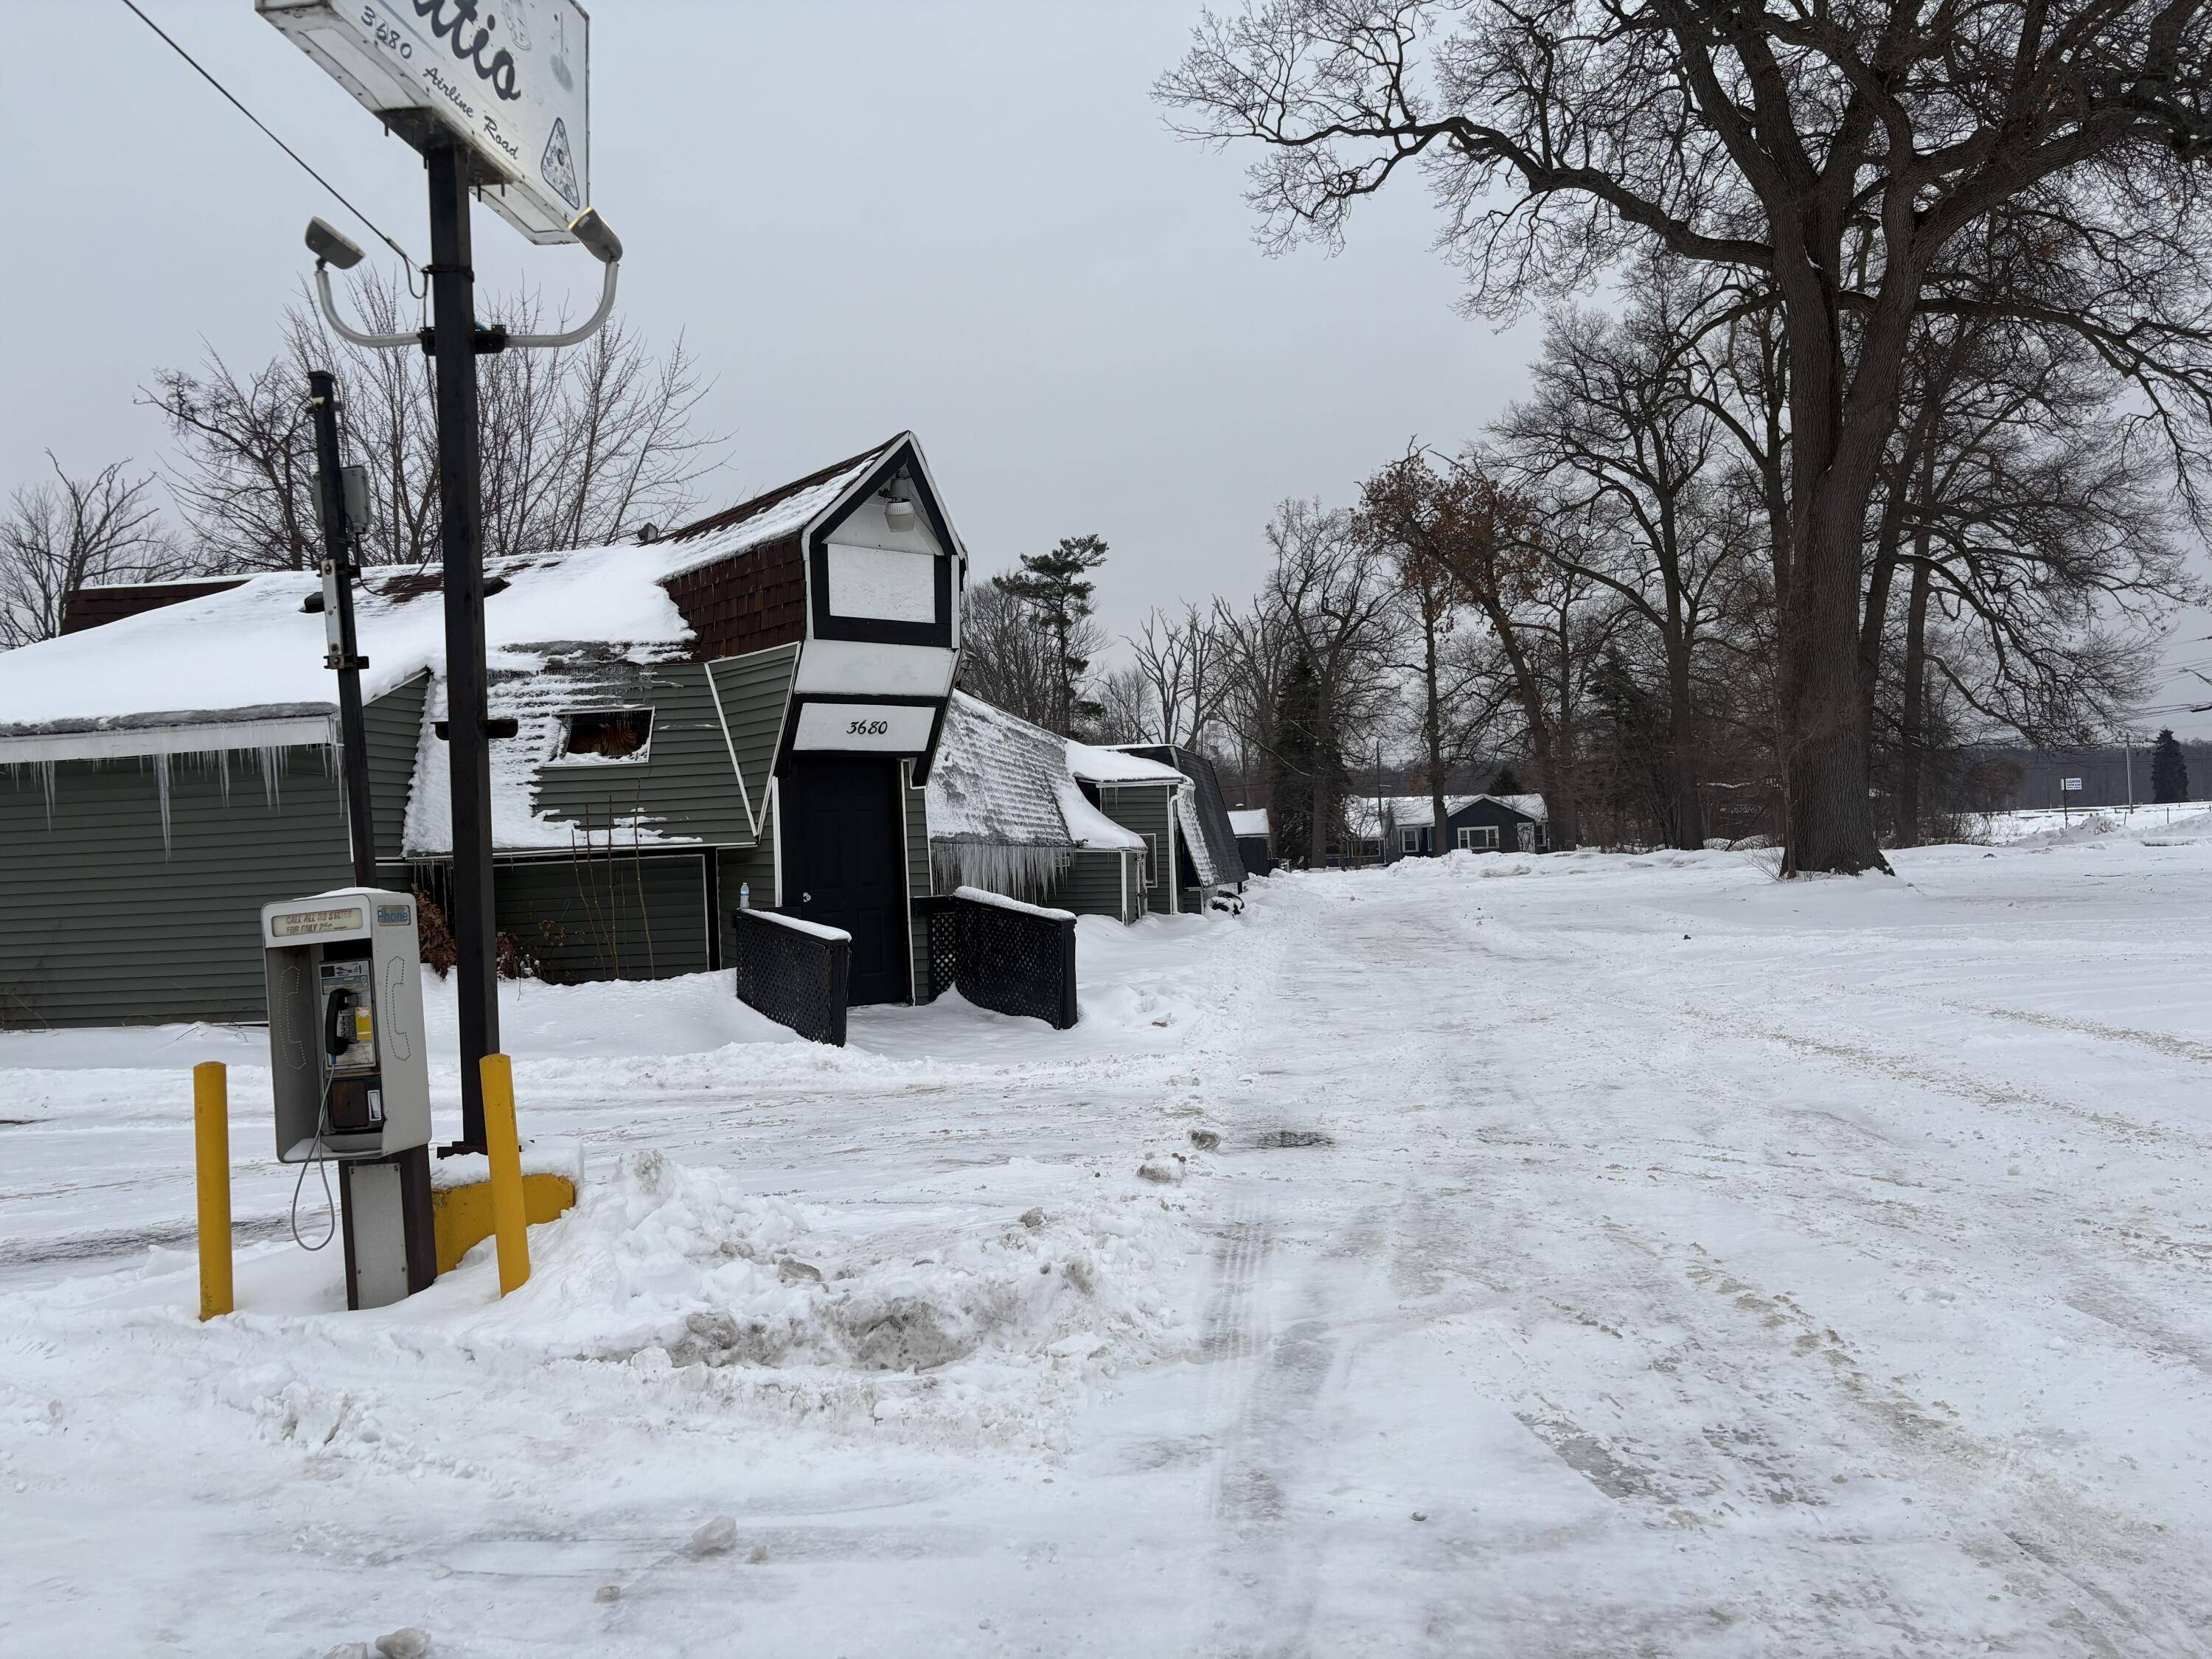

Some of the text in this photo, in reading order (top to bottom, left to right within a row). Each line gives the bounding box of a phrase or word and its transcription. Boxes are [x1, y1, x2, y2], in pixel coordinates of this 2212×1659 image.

[361, 5, 518, 159] 3680 Airline Road
[846, 720, 888, 734] 3680
[377, 908, 408, 922] Phone
